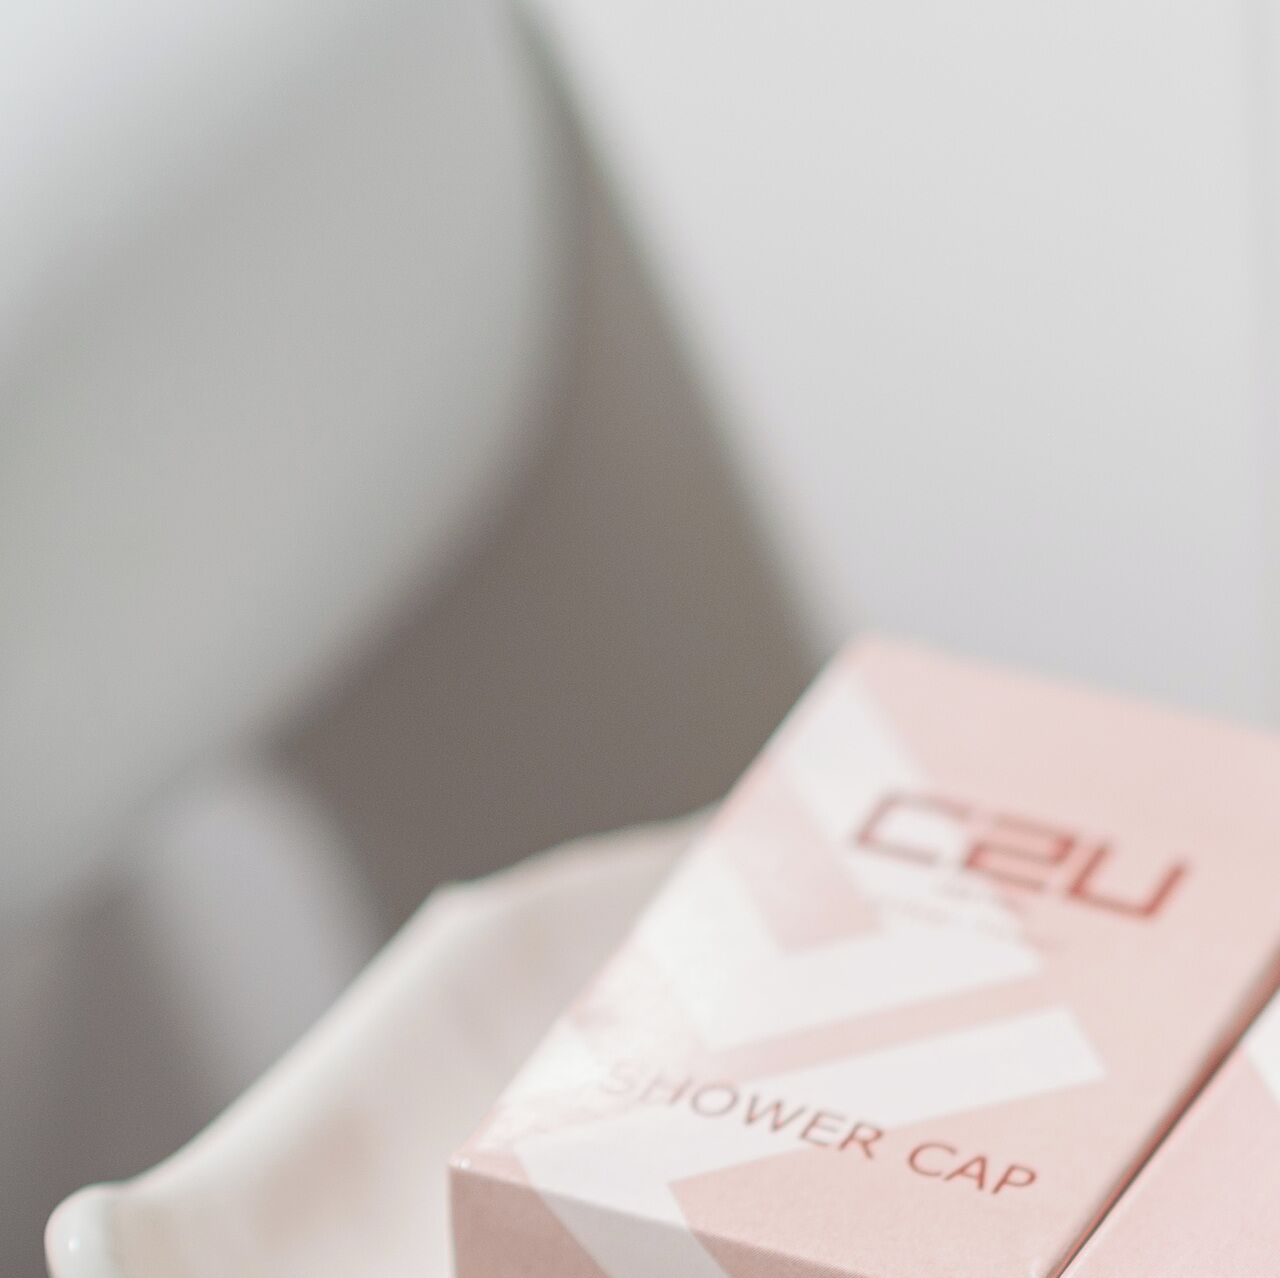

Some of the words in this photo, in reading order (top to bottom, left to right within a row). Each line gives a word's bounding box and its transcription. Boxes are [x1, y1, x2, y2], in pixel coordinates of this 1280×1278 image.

[854, 791, 1188, 918] C2U
[601, 1061, 885, 1159] SHOWER
[907, 1142, 1037, 1195] CAP
